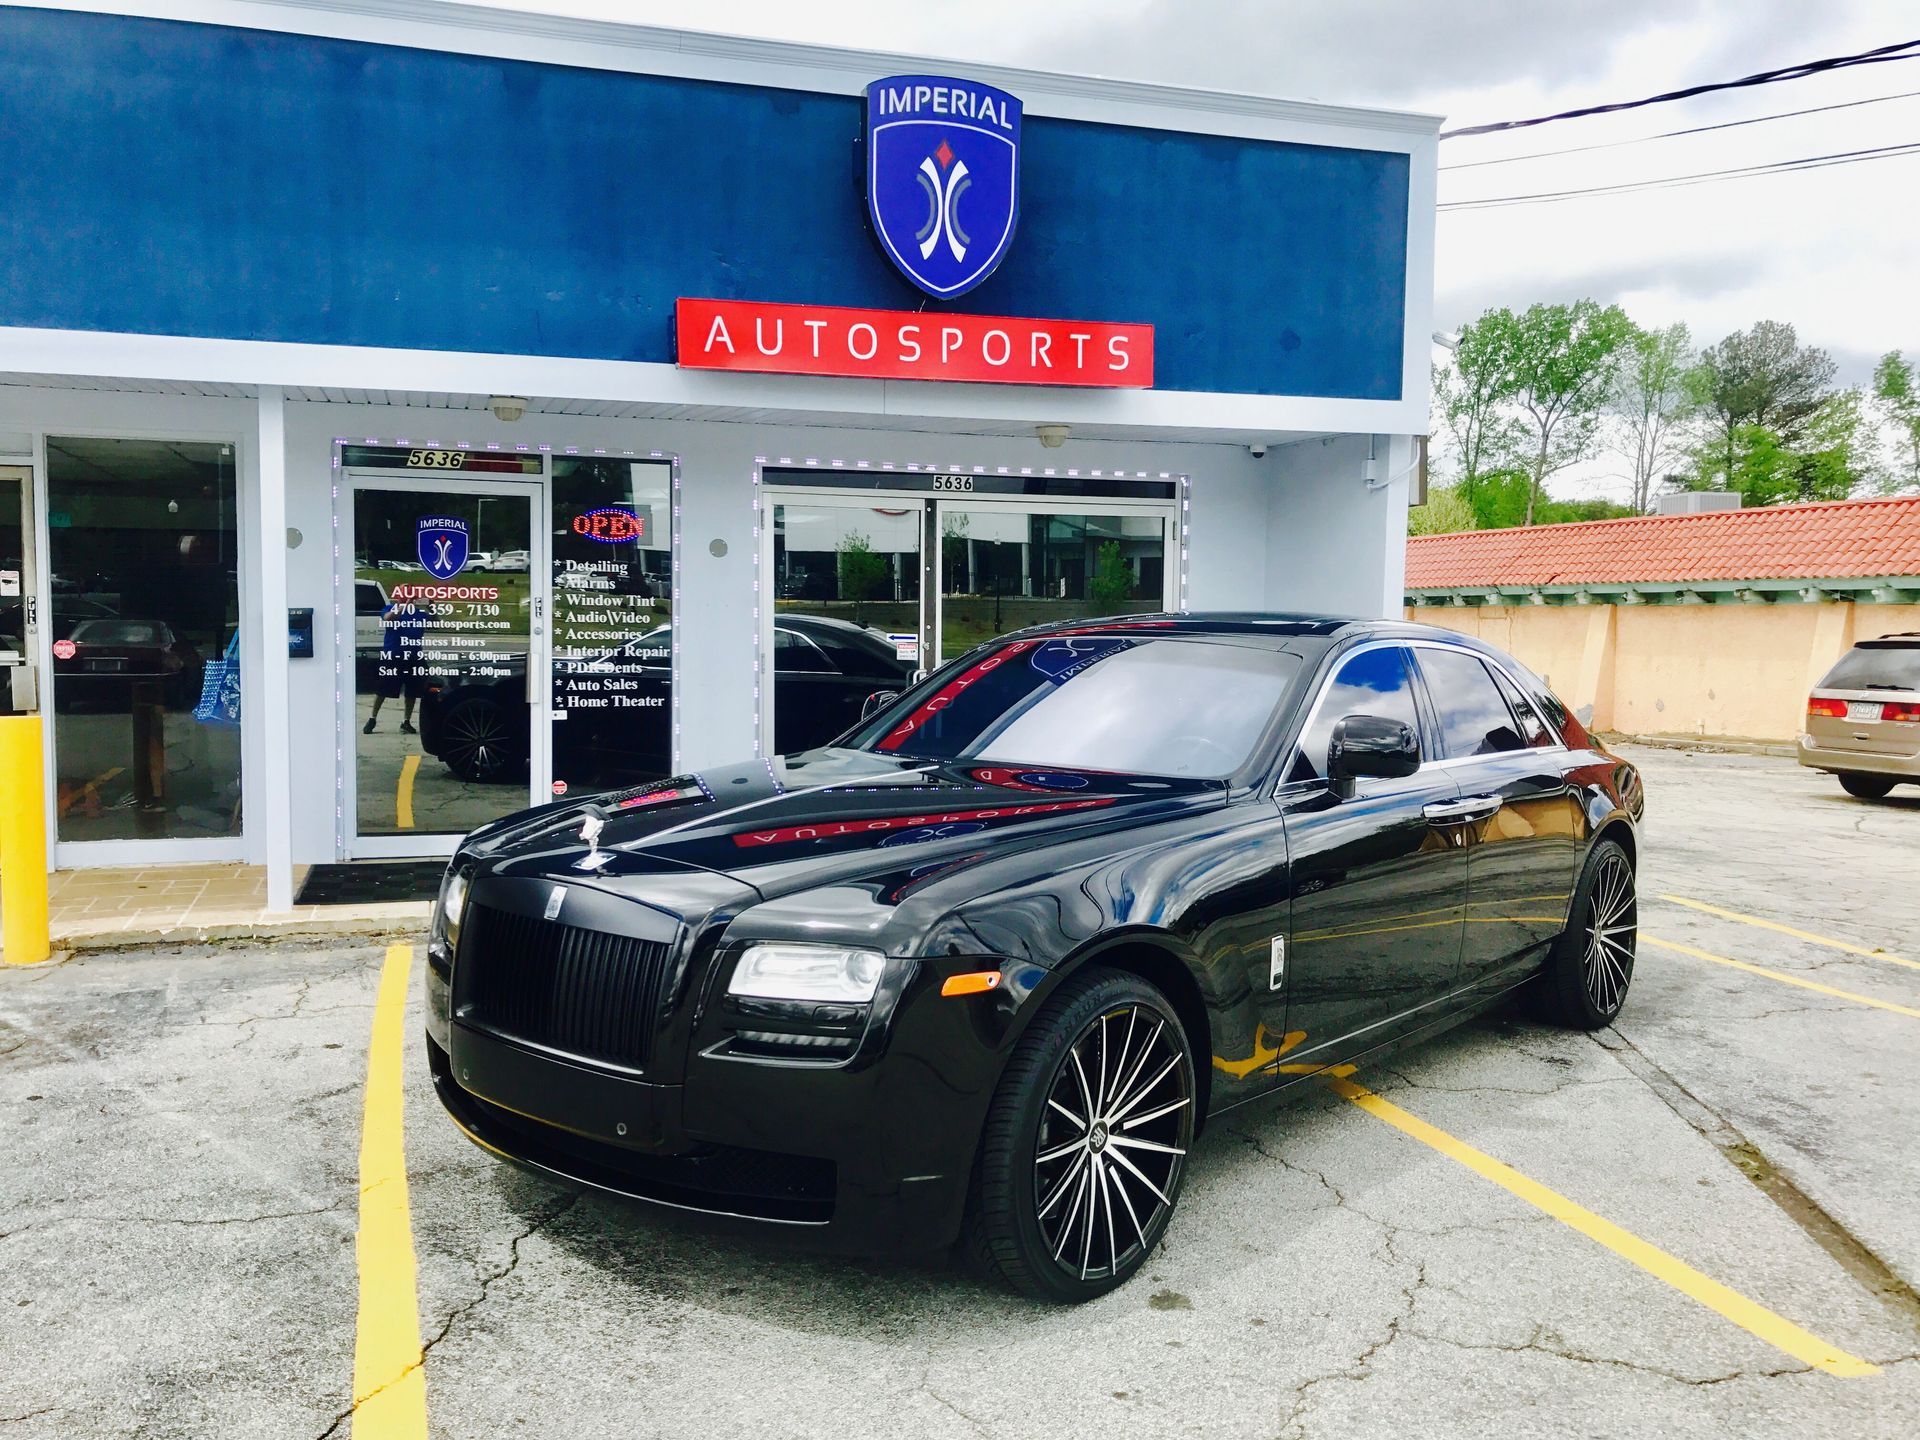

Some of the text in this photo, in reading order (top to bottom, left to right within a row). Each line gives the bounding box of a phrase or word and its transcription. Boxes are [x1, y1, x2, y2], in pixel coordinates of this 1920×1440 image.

[879, 86, 1013, 130] IMPERIAL
[703, 315, 1130, 371] AUTOSPORTS
[410, 451, 462, 467] 5636
[934, 476, 972, 490] 5636
[420, 518, 467, 531] IMPERIAL
[573, 514, 645, 537] OPEN
[565, 559, 628, 575] Detailing
[565, 577, 616, 589] Alarms
[391, 586, 498, 599] AUTOSPORTS
[565, 593, 656, 607] Window Tint
[390, 603, 415, 615] 470
[429, 603, 454, 615] 359
[468, 604, 499, 616] 7130
[378, 618, 511, 630] imperialautosports.com
[565, 609, 651, 626] Audio\Video
[565, 628, 642, 640] Accessories
[400, 636, 486, 647] Business Hours
[380, 651, 392, 660] M
[403, 651, 411, 660] F
[417, 651, 459, 661] 9:00am
[469, 651, 511, 664] 6:00pm
[566, 645, 670, 660] Interior Repair
[378, 666, 398, 676] Sat
[412, 666, 459, 676] 10:00am
[469, 666, 512, 678] 2:00pm
[603, 662, 643, 673] Dents
[566, 678, 638, 690] Auto Sales
[567, 695, 665, 707] Home Theater
